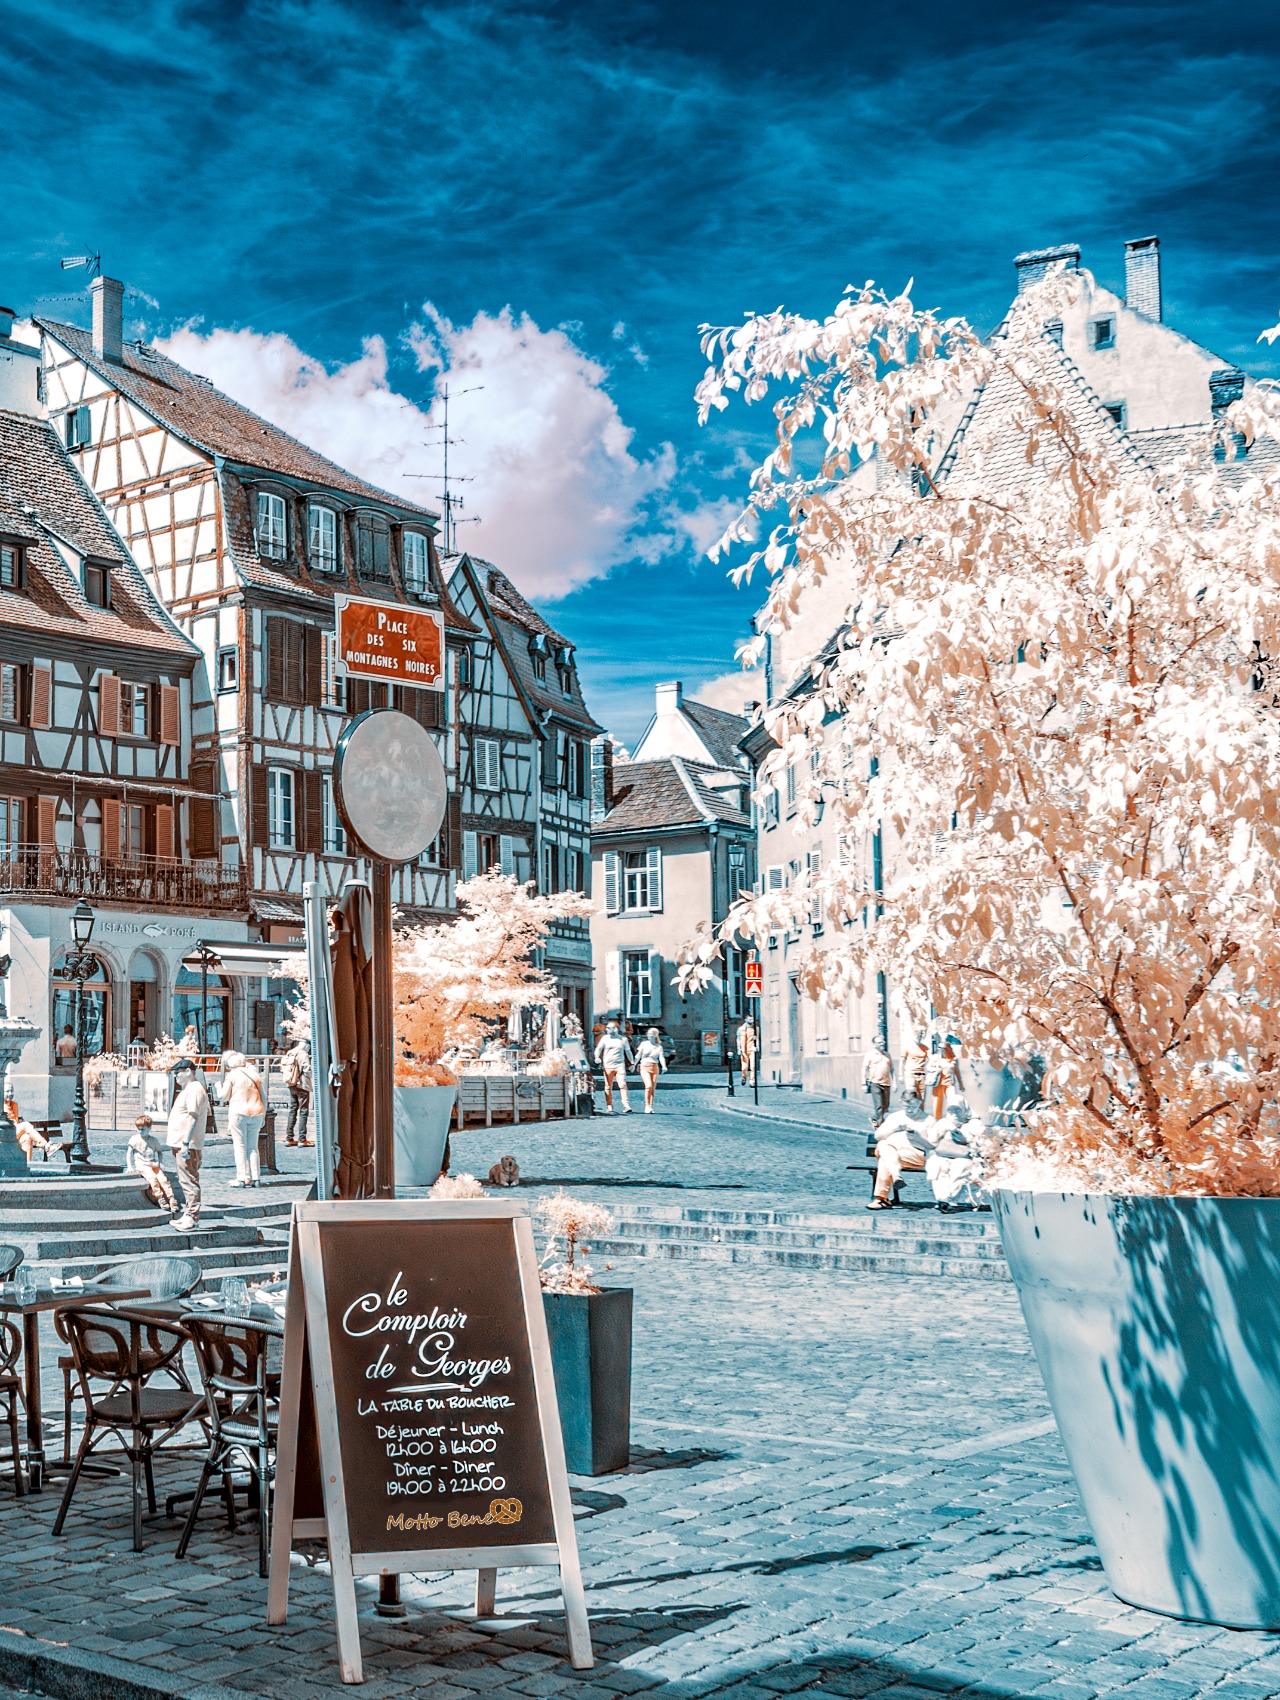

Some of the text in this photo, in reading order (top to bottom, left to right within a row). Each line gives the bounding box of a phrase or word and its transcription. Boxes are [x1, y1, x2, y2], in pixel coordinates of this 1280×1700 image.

[367, 633, 417, 653] DES SIX
[346, 650, 435, 676] MONTAGNES NOIRES
[102, 922, 140, 934] ISLAND
[386, 1271, 408, 1306] le
[365, 1331, 512, 1387] de Georges
[357, 1399, 379, 1416] LA
[382, 1399, 423, 1412] TABLE
[376, 1424, 446, 1442] Déjeuner
[461, 1421, 504, 1436] Lunch
[439, 1440, 448, 1455] à
[393, 1462, 436, 1477] Dîner
[438, 1478, 447, 1493] à
[447, 1510, 496, 1528] Bene
